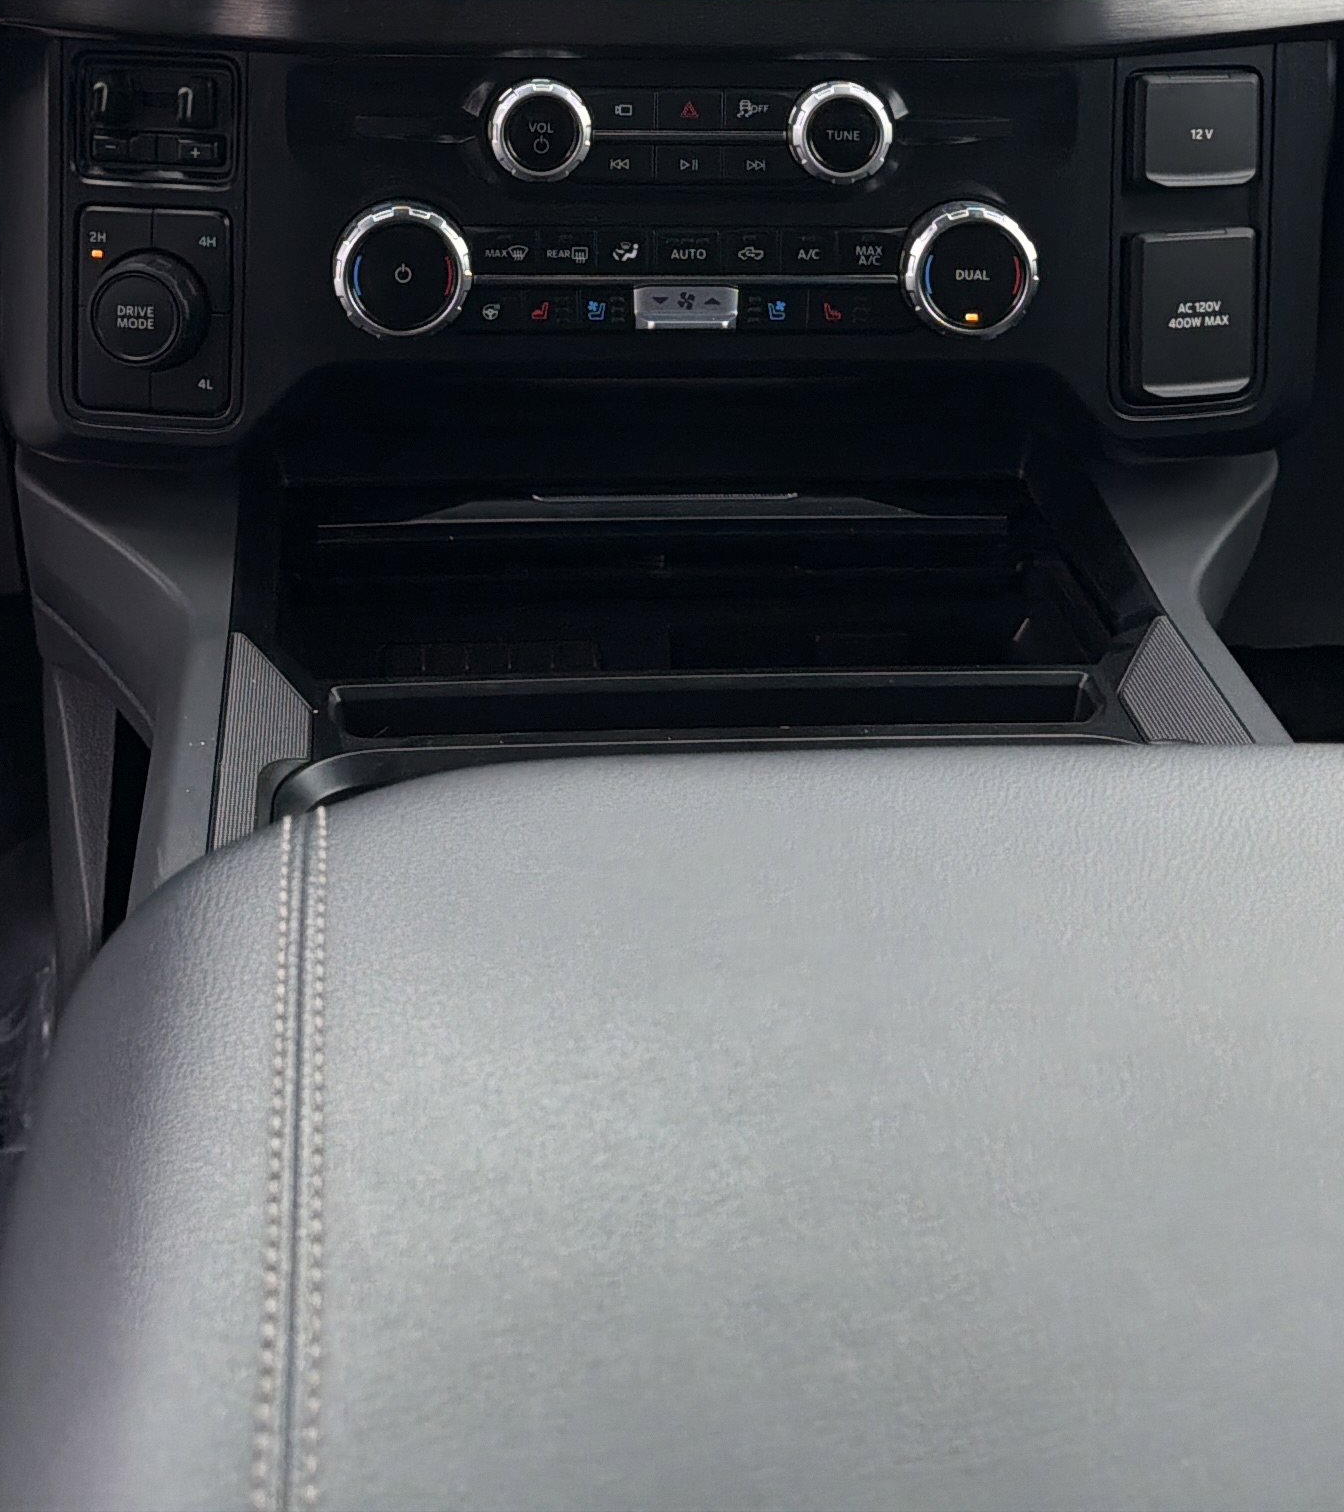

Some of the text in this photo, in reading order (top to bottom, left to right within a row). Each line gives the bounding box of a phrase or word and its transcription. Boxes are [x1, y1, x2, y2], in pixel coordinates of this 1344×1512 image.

[751, 103, 770, 114] OFF
[528, 122, 554, 134] VOL
[826, 129, 861, 141] TUNE
[1190, 129, 1214, 140] 12 V
[89, 231, 107, 243] 2H
[198, 236, 217, 248] 4H
[485, 248, 507, 258] MAX
[546, 248, 571, 259] REAR
[671, 248, 707, 260] AUTO
[797, 248, 820, 261] A/C
[856, 245, 883, 256] MAX
[858, 255, 881, 266] A/C
[956, 269, 991, 282] DUAL
[117, 305, 155, 318] DRIVE
[1177, 300, 1221, 314] AC 120V
[117, 317, 155, 330] MODE
[1168, 314, 1229, 329] 400W MAX
[197, 378, 214, 390] 4L
